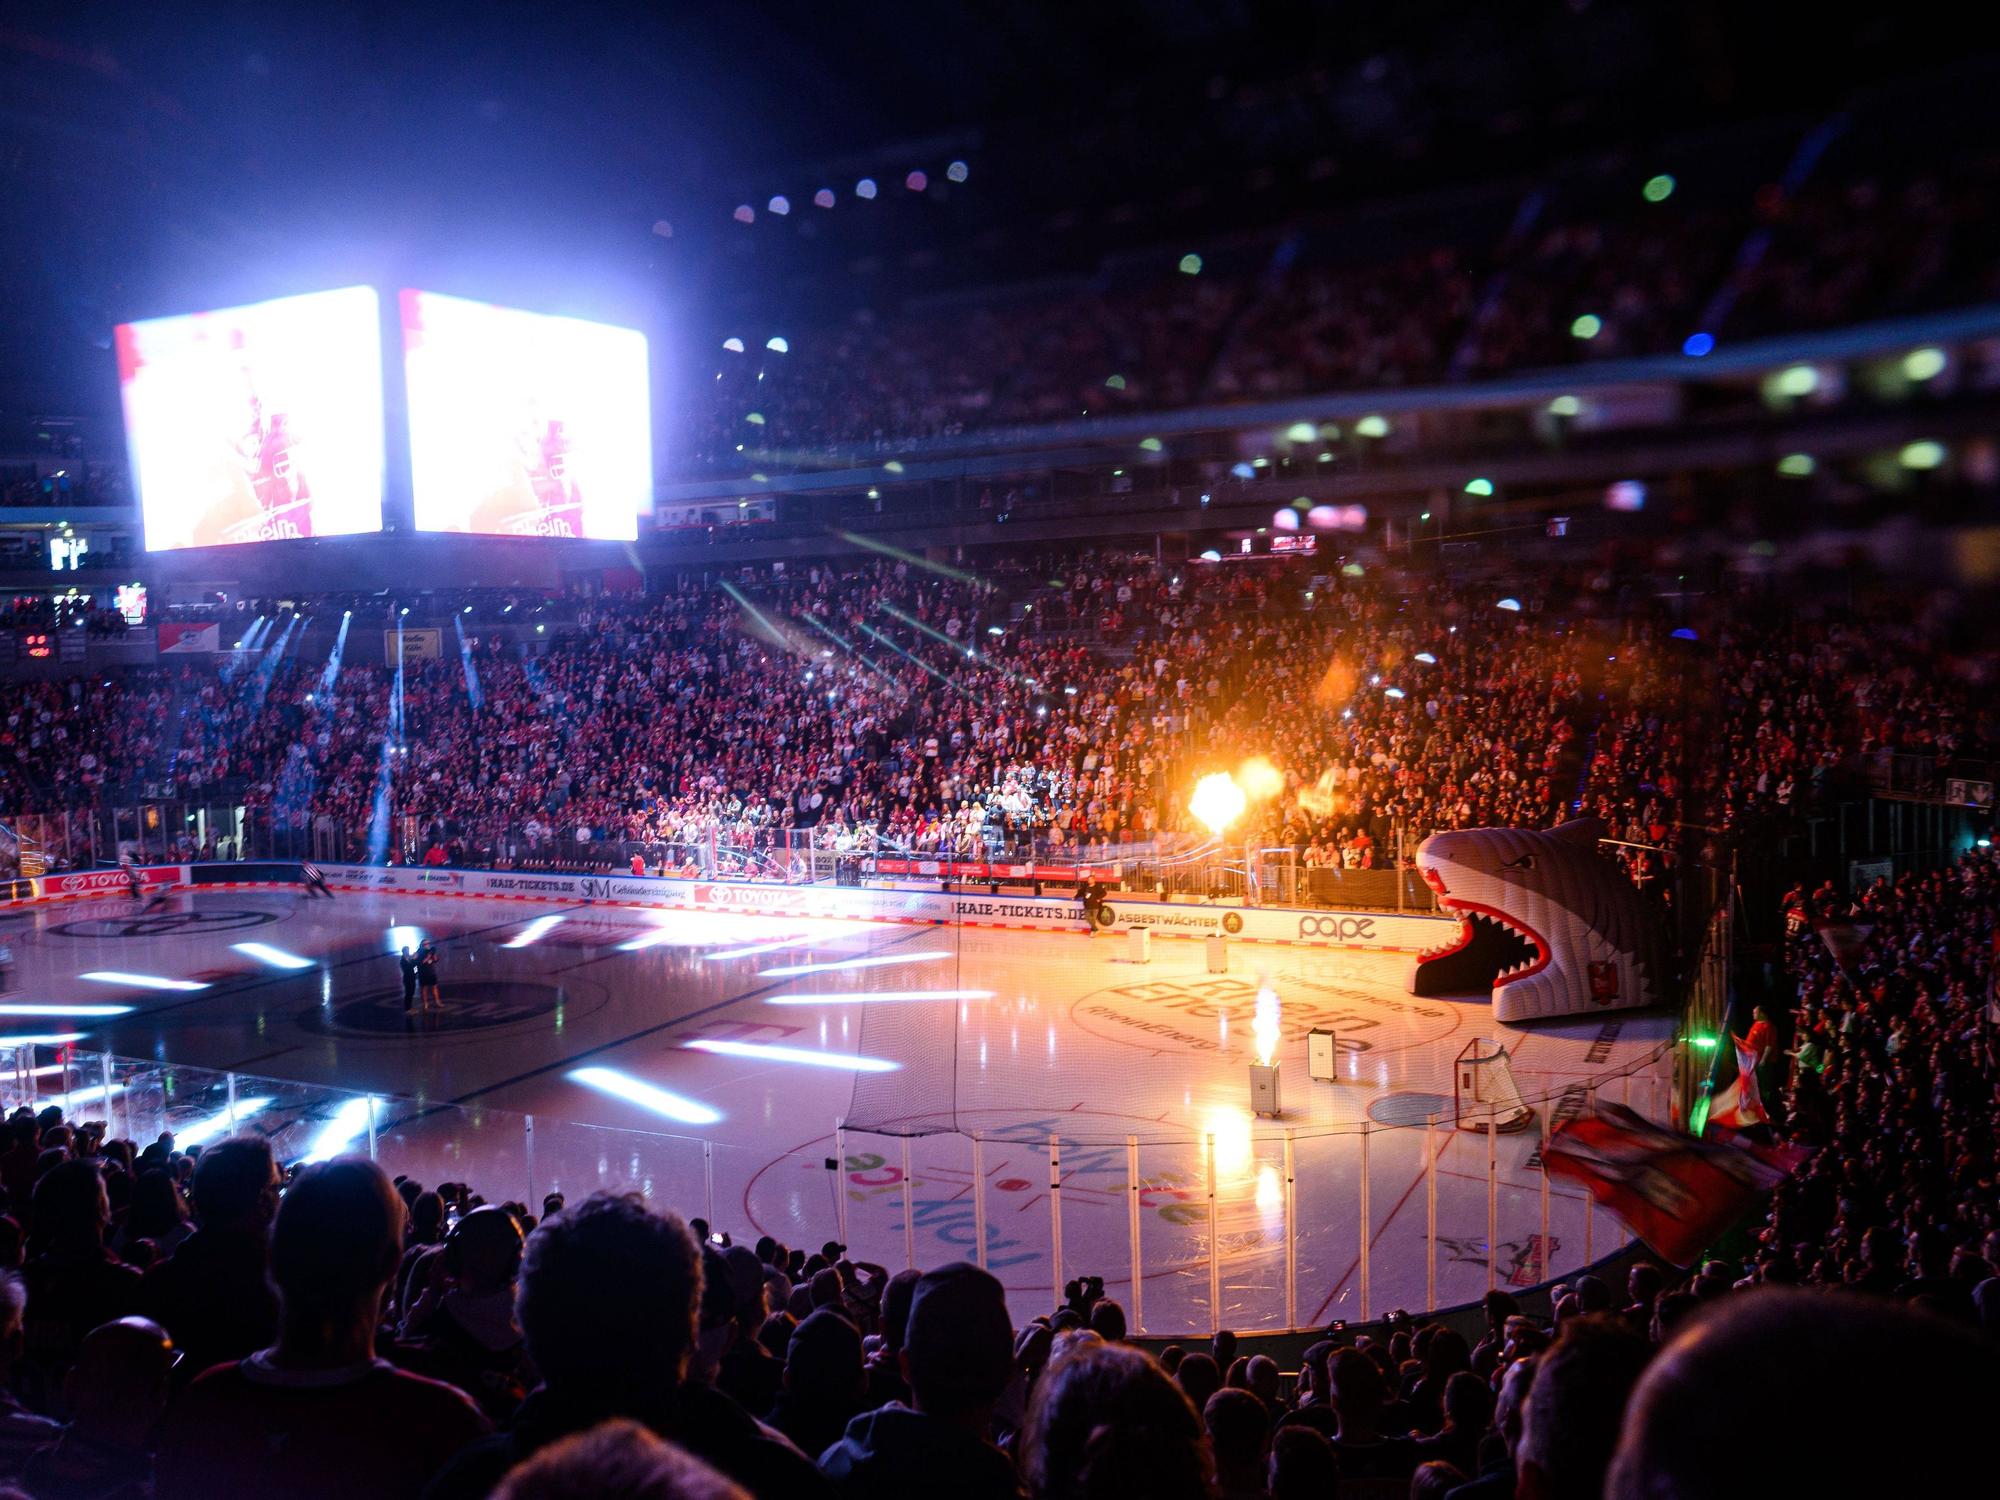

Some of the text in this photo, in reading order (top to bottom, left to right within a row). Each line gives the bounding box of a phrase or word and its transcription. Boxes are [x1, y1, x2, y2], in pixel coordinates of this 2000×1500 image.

[88, 871, 151, 888] TOYOA
[490, 877, 575, 892] HAIE-TICKETS.DE
[733, 889, 791, 905] TOYOTA
[956, 901, 1087, 921] HAIE-TICKETS.DE
[1118, 912, 1218, 928] ASBESTWÄCHTER
[1299, 915, 1376, 941] pape
